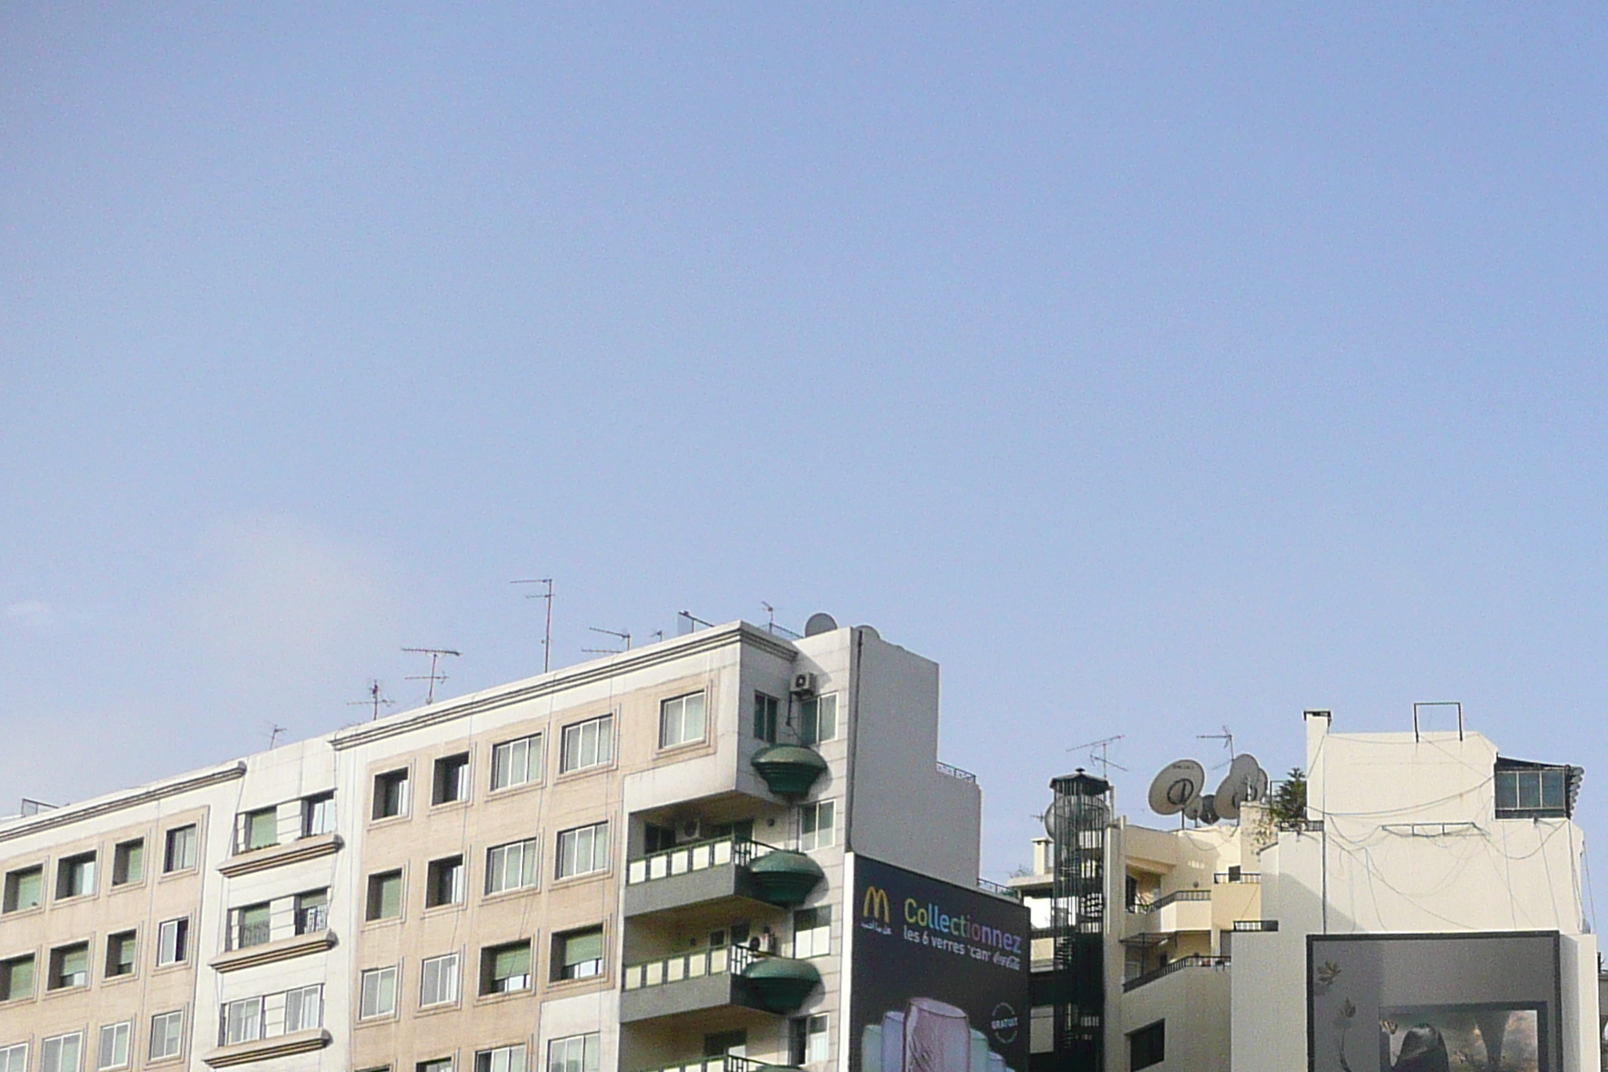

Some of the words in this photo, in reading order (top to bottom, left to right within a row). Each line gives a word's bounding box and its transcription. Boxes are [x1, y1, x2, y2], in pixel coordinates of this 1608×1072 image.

[903, 924, 920, 943] les
[922, 930, 929, 945] 6
[931, 934, 965, 955] verres
[904, 898, 1022, 954] Collectionnez
